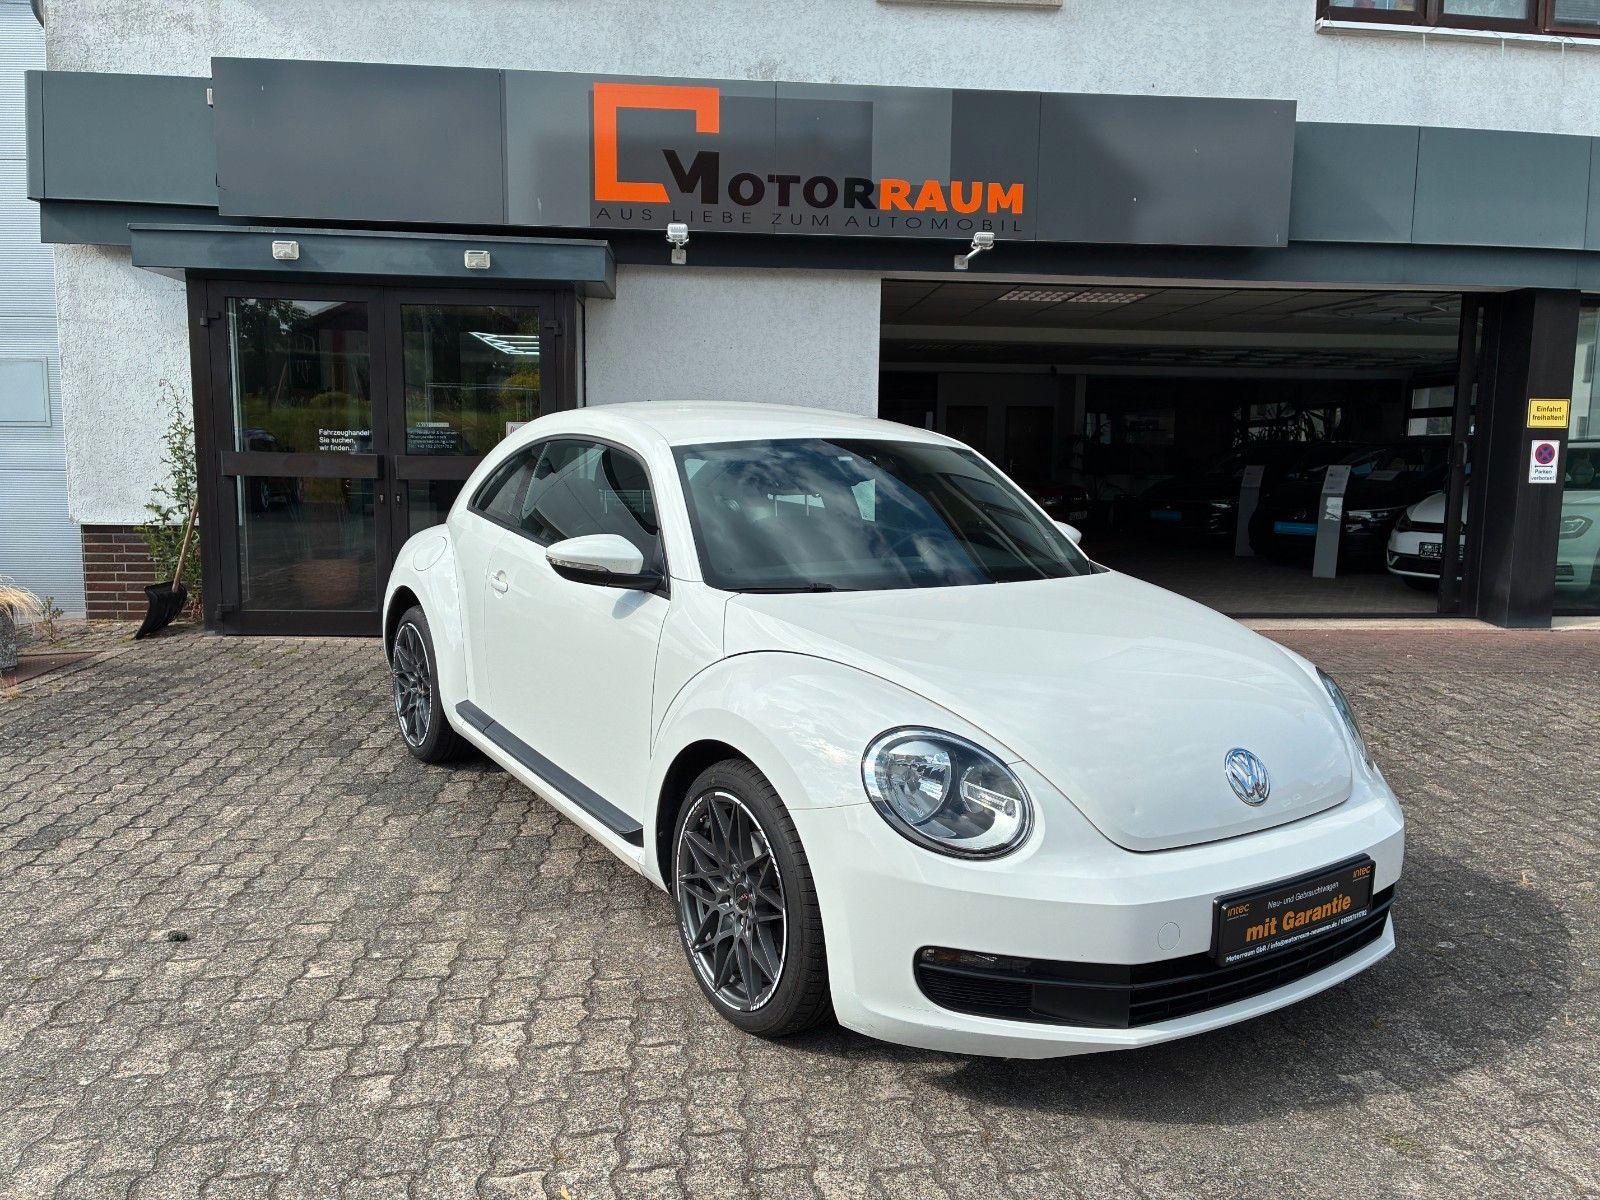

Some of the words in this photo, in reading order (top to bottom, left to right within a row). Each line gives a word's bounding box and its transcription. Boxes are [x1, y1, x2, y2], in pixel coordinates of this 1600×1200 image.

[596, 207, 653, 222] AUS
[671, 210, 752, 225] LIEBE
[772, 212, 830, 228] ZUM
[845, 215, 1023, 233] AUTOMOBIL
[1532, 413, 1565, 421] freihalten!
[318, 428, 370, 437] Fahrzeughandel
[331, 436, 356, 444] suchen,
[1352, 865, 1372, 879] intec
[1267, 900, 1283, 910] Neu-
[1283, 895, 1295, 905] und
[1295, 881, 1339, 901] Gebrauchtwagen
[1227, 903, 1250, 917] intec
[1245, 916, 1278, 943] mit
[1282, 893, 1352, 932] Garantie
[1225, 949, 1256, 963] Motorraum
